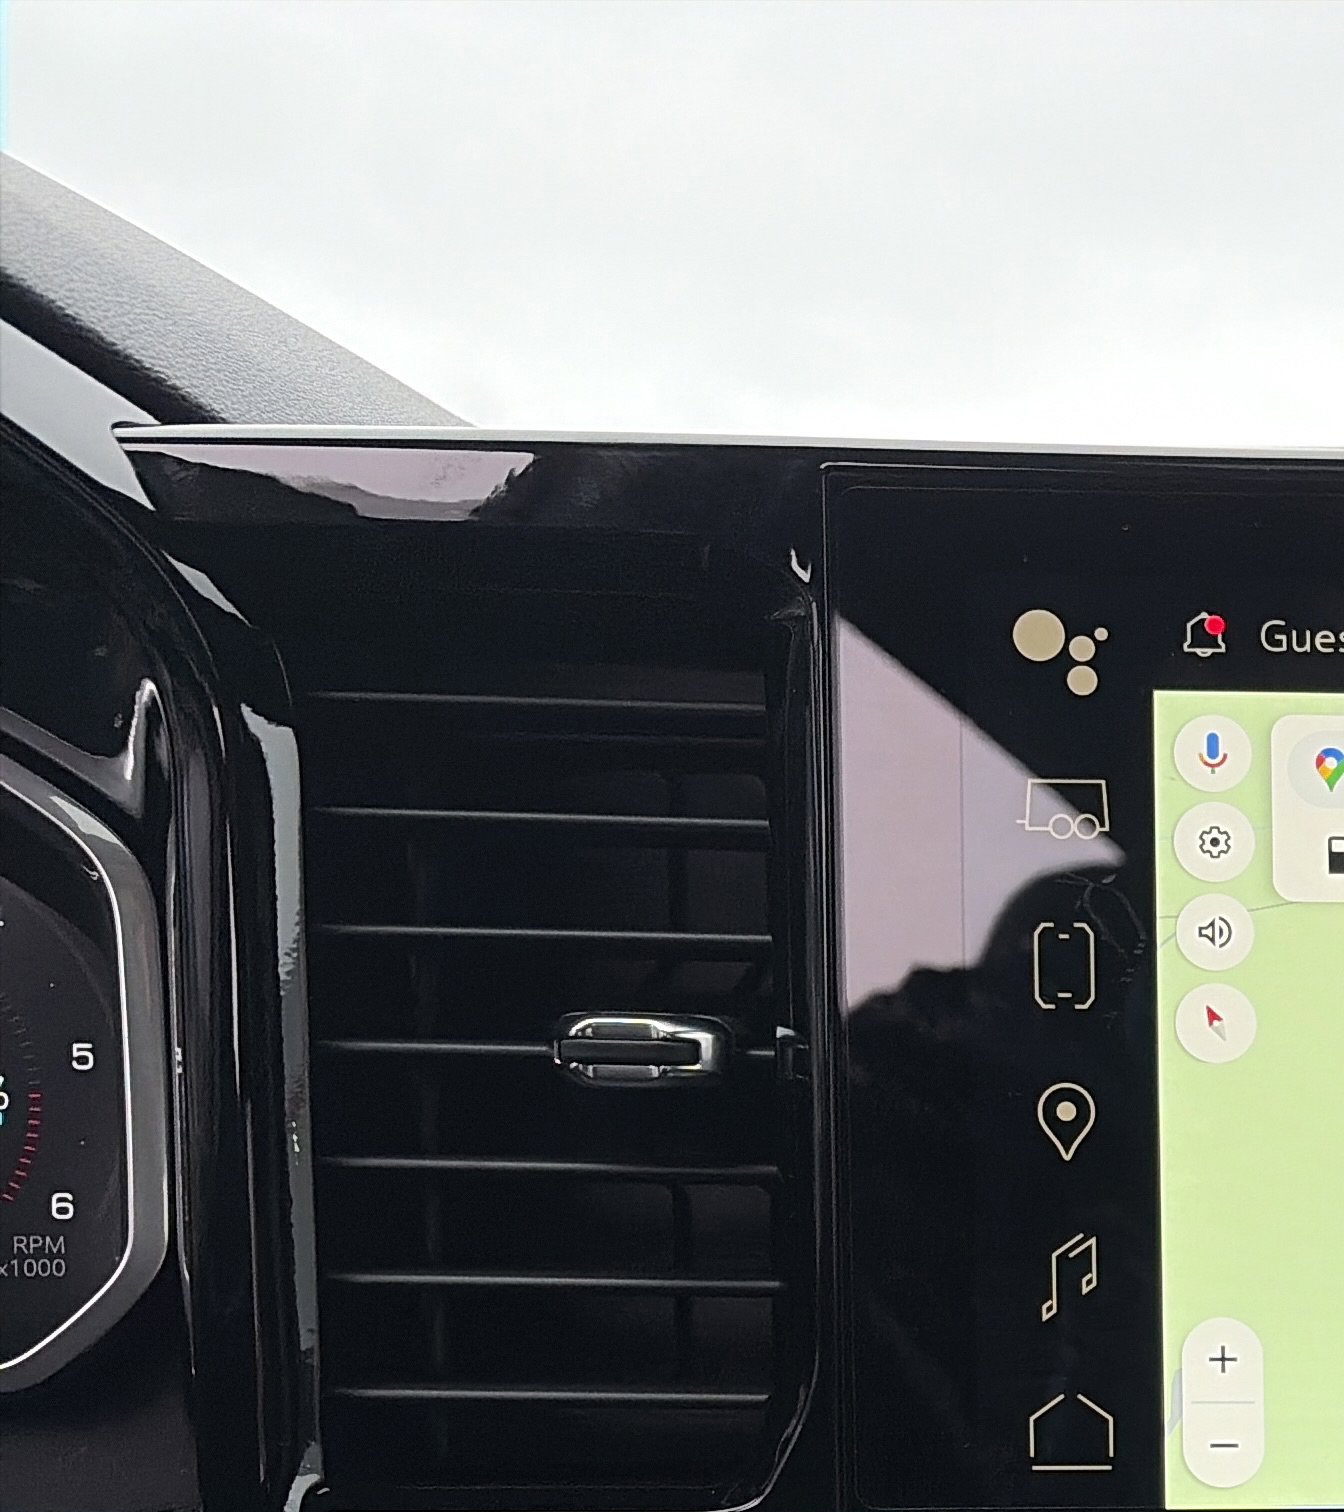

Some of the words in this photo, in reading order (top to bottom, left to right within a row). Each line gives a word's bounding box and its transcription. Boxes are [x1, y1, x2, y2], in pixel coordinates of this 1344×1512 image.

[71, 1043, 94, 1071] 5
[51, 1192, 74, 1220] 6
[13, 1235, 65, 1255] RPM
[0, 1258, 66, 1277] x1000
